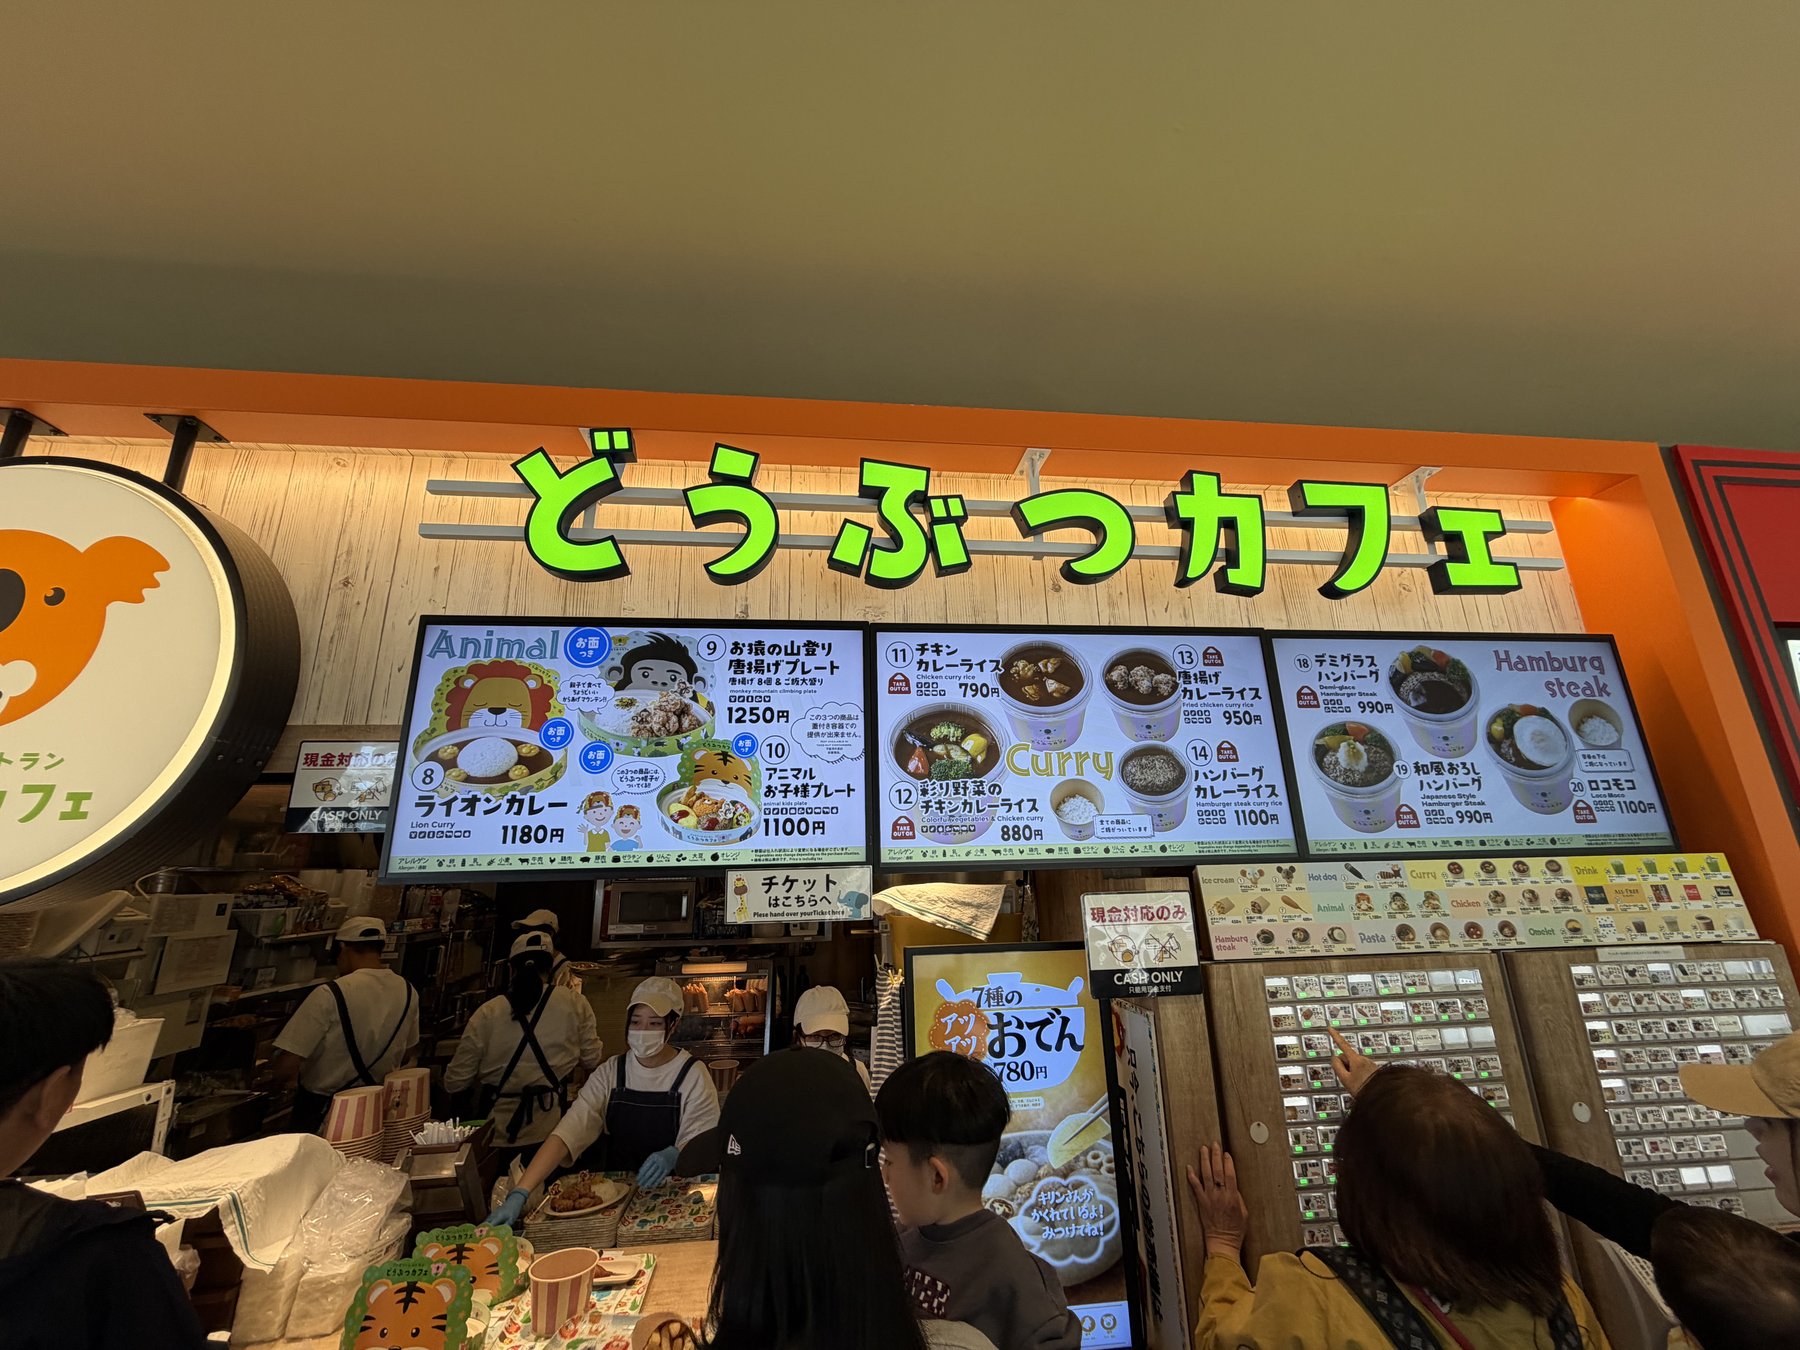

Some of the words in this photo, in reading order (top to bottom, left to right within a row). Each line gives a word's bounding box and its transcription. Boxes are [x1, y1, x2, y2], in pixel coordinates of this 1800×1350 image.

[511, 427, 1523, 598] どうぶつカフェ
[426, 628, 561, 660] Animal
[576, 636, 600, 649] お面
[705, 640, 718, 657] 9
[729, 640, 833, 657] お猿の山登り
[915, 643, 959, 657] チキン
[891, 648, 907, 663] 11
[1178, 650, 1194, 664] 13
[1296, 657, 1310, 669] 18
[1314, 653, 1378, 668] デミグラス
[1493, 649, 1606, 675] Hamburg
[727, 659, 840, 676] 唐揚げプレート
[915, 658, 1004, 673] カレーライス
[945, 675, 963, 683] curry
[1178, 670, 1221, 685] 唐揚げ
[1317, 668, 1380, 684] ハンバーグ
[958, 682, 1000, 699] 790円
[1181, 687, 1263, 700] カレーライス
[1320, 690, 1357, 698] Hamburger
[1544, 675, 1612, 699] steak
[1357, 700, 1395, 715] 990円
[726, 706, 790, 725] 1250円
[1222, 710, 1263, 726] 950円
[547, 725, 566, 736] お面
[766, 742, 785, 758] 10
[1191, 745, 1209, 761] 14
[1005, 743, 1114, 781] Curry
[1413, 761, 1481, 776] 和風おろし
[421, 768, 435, 785] 8
[765, 767, 816, 781] アニマル
[1193, 765, 1265, 782] ハンバーグ
[1395, 764, 1409, 776] 19
[763, 782, 856, 799] お子様プレート
[919, 781, 1003, 797] 彩り野菜の
[1194, 784, 1280, 799] カレーライス
[1418, 776, 1483, 792] ハンバーグ
[1570, 781, 1585, 793] 20
[1588, 778, 1637, 791] ロコモコ
[0, 784, 93, 824] フェ
[895, 789, 912, 804] 12
[1196, 800, 1232, 808] Hamburger
[1421, 799, 1463, 808] Hamburger
[414, 793, 568, 818] ライオンカレー
[919, 798, 1039, 815] チキンカレーライス
[1616, 800, 1657, 815] 1100円
[348, 810, 383, 821] ONLY
[1026, 815, 1044, 823] curry
[1234, 809, 1280, 826] 1100円
[1455, 809, 1494, 824] 990円
[410, 820, 430, 829] Lion
[431, 821, 456, 831] Curry
[763, 817, 826, 837] 1100円
[1000, 824, 1043, 842] 880円
[501, 824, 565, 846] 1180円
[1410, 870, 1437, 880] Curry
[1575, 865, 1598, 876] Drink
[761, 873, 838, 895] チケット
[1213, 876, 1235, 884] cream
[768, 894, 832, 908] はこちらへ
[1317, 902, 1346, 913] Animal
[1451, 899, 1481, 908] Chicken
[1090, 905, 1187, 923] 現金対応のみ
[1214, 935, 1249, 943] Hamburg
[1358, 932, 1387, 944] Pasta
[1216, 943, 1237, 951] steak
[1114, 972, 1148, 985] CASH
[1151, 971, 1183, 984] ONLY
[972, 986, 1023, 1009] 7種の
[987, 1007, 1085, 1060] おでん
[993, 1060, 1048, 1082] 780円
[1037, 1188, 1095, 1205] キリンさんが
[1041, 1221, 1104, 1240] みつけてね!
